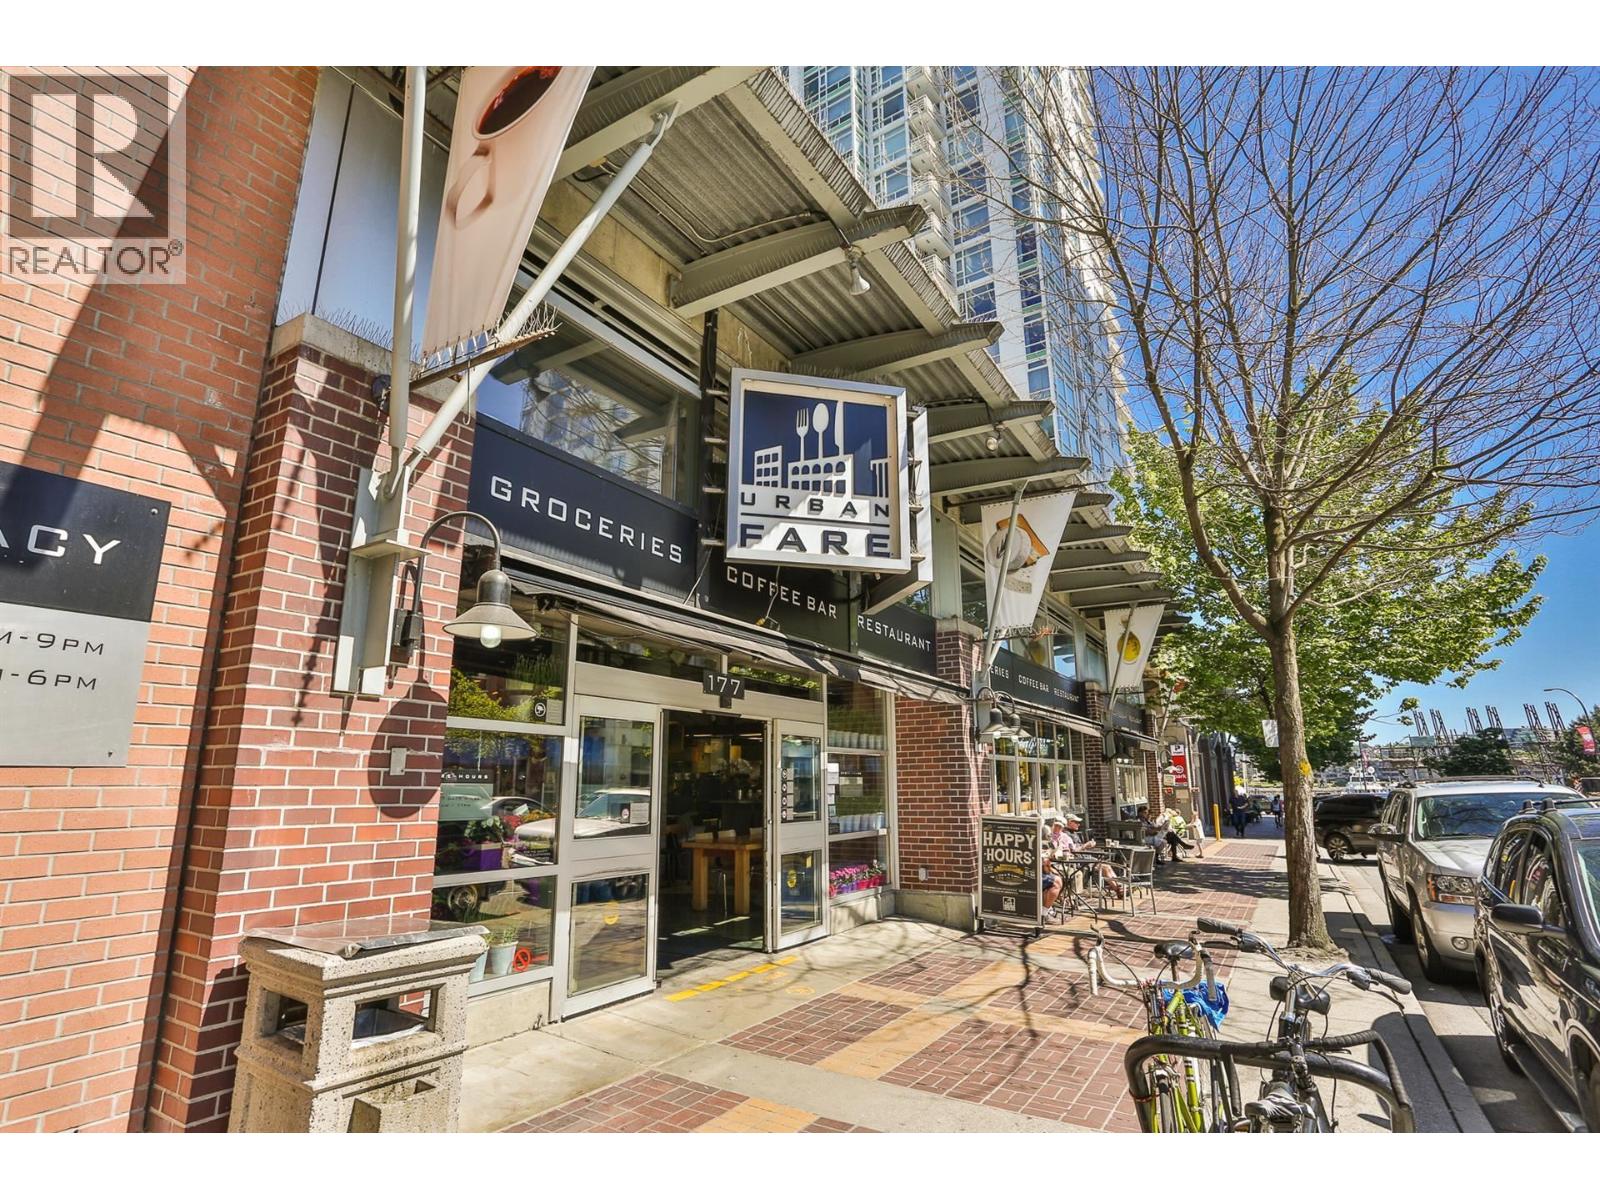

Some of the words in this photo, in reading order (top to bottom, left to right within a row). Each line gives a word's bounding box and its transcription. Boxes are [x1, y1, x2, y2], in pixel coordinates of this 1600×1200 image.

[490, 475, 682, 565] GROCERIES
[740, 491, 890, 519] URBAN
[0, 524, 122, 565] CY
[740, 523, 891, 559] FARE
[726, 566, 801, 606] COFFEE
[807, 596, 838, 620] BAR
[857, 614, 931, 652] RESTAURANT
[708, 674, 741, 696] 177
[1018, 674, 1039, 689] COFFEE
[983, 831, 1036, 850] HAPPY
